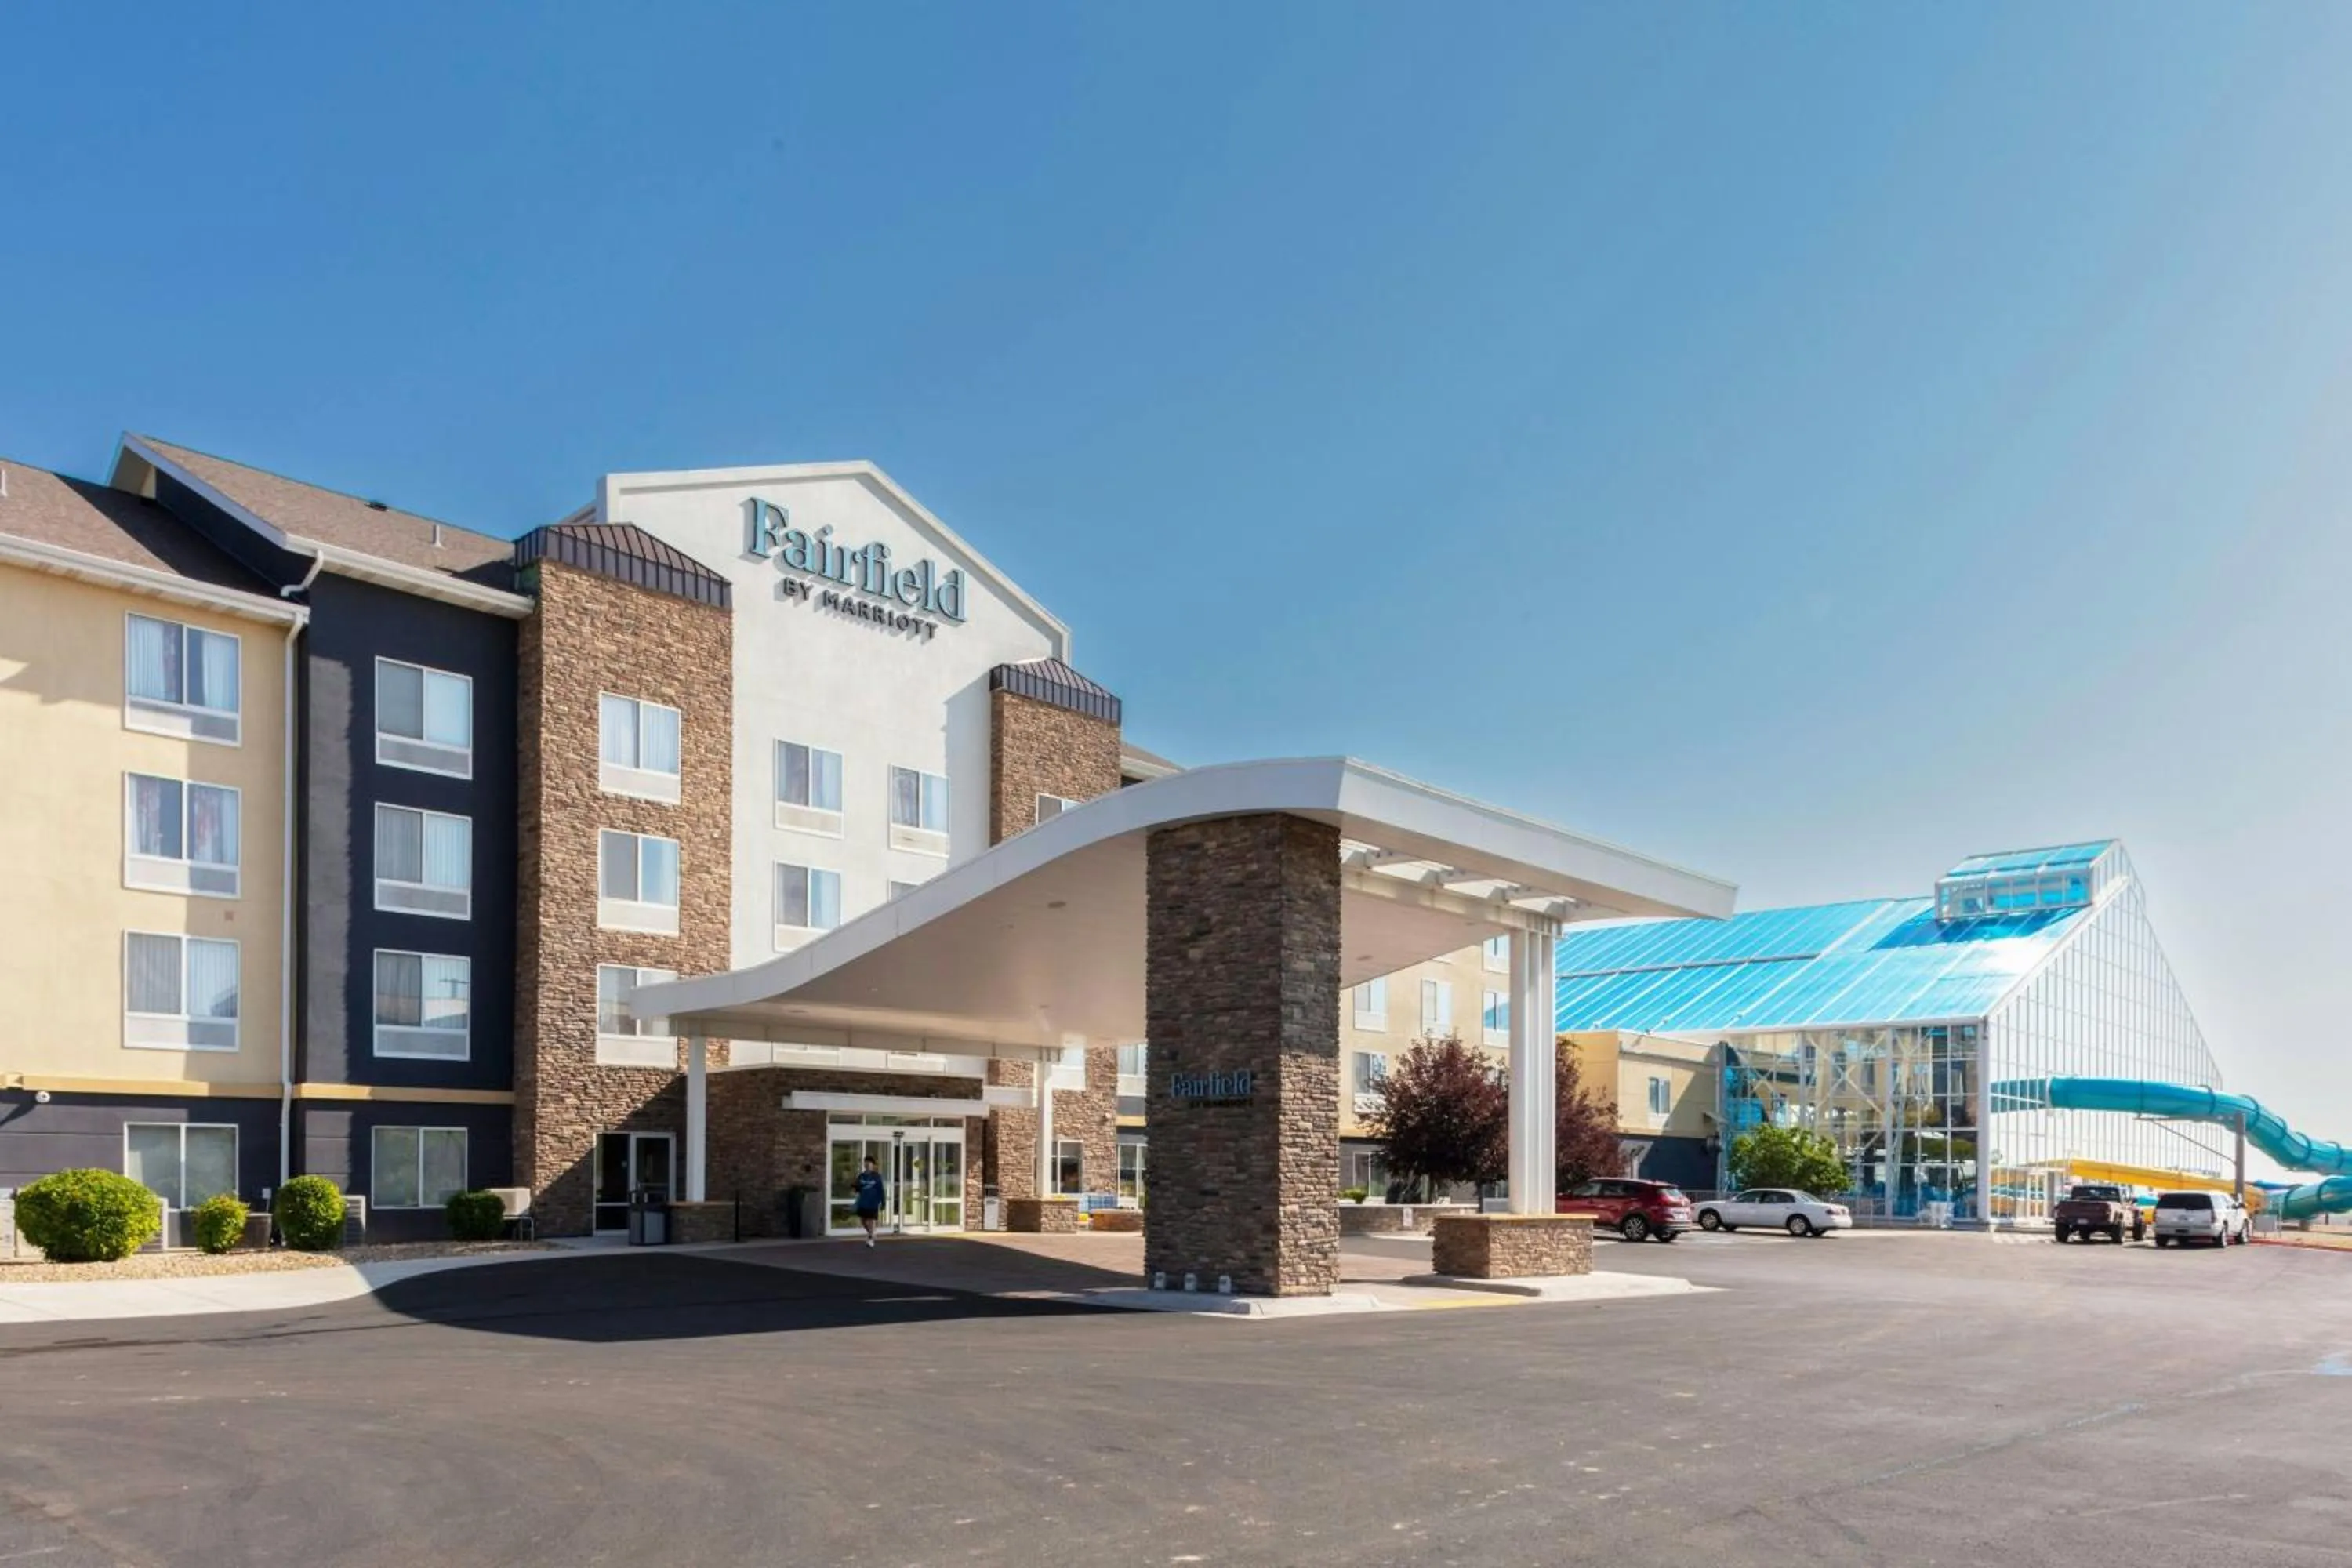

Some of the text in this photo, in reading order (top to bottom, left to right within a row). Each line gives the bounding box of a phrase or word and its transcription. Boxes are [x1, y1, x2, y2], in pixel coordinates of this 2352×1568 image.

[748, 496, 968, 623] Fairfield
[784, 576, 939, 640] BY MARRIOTT
[1171, 1069, 1252, 1098] Fairfield
